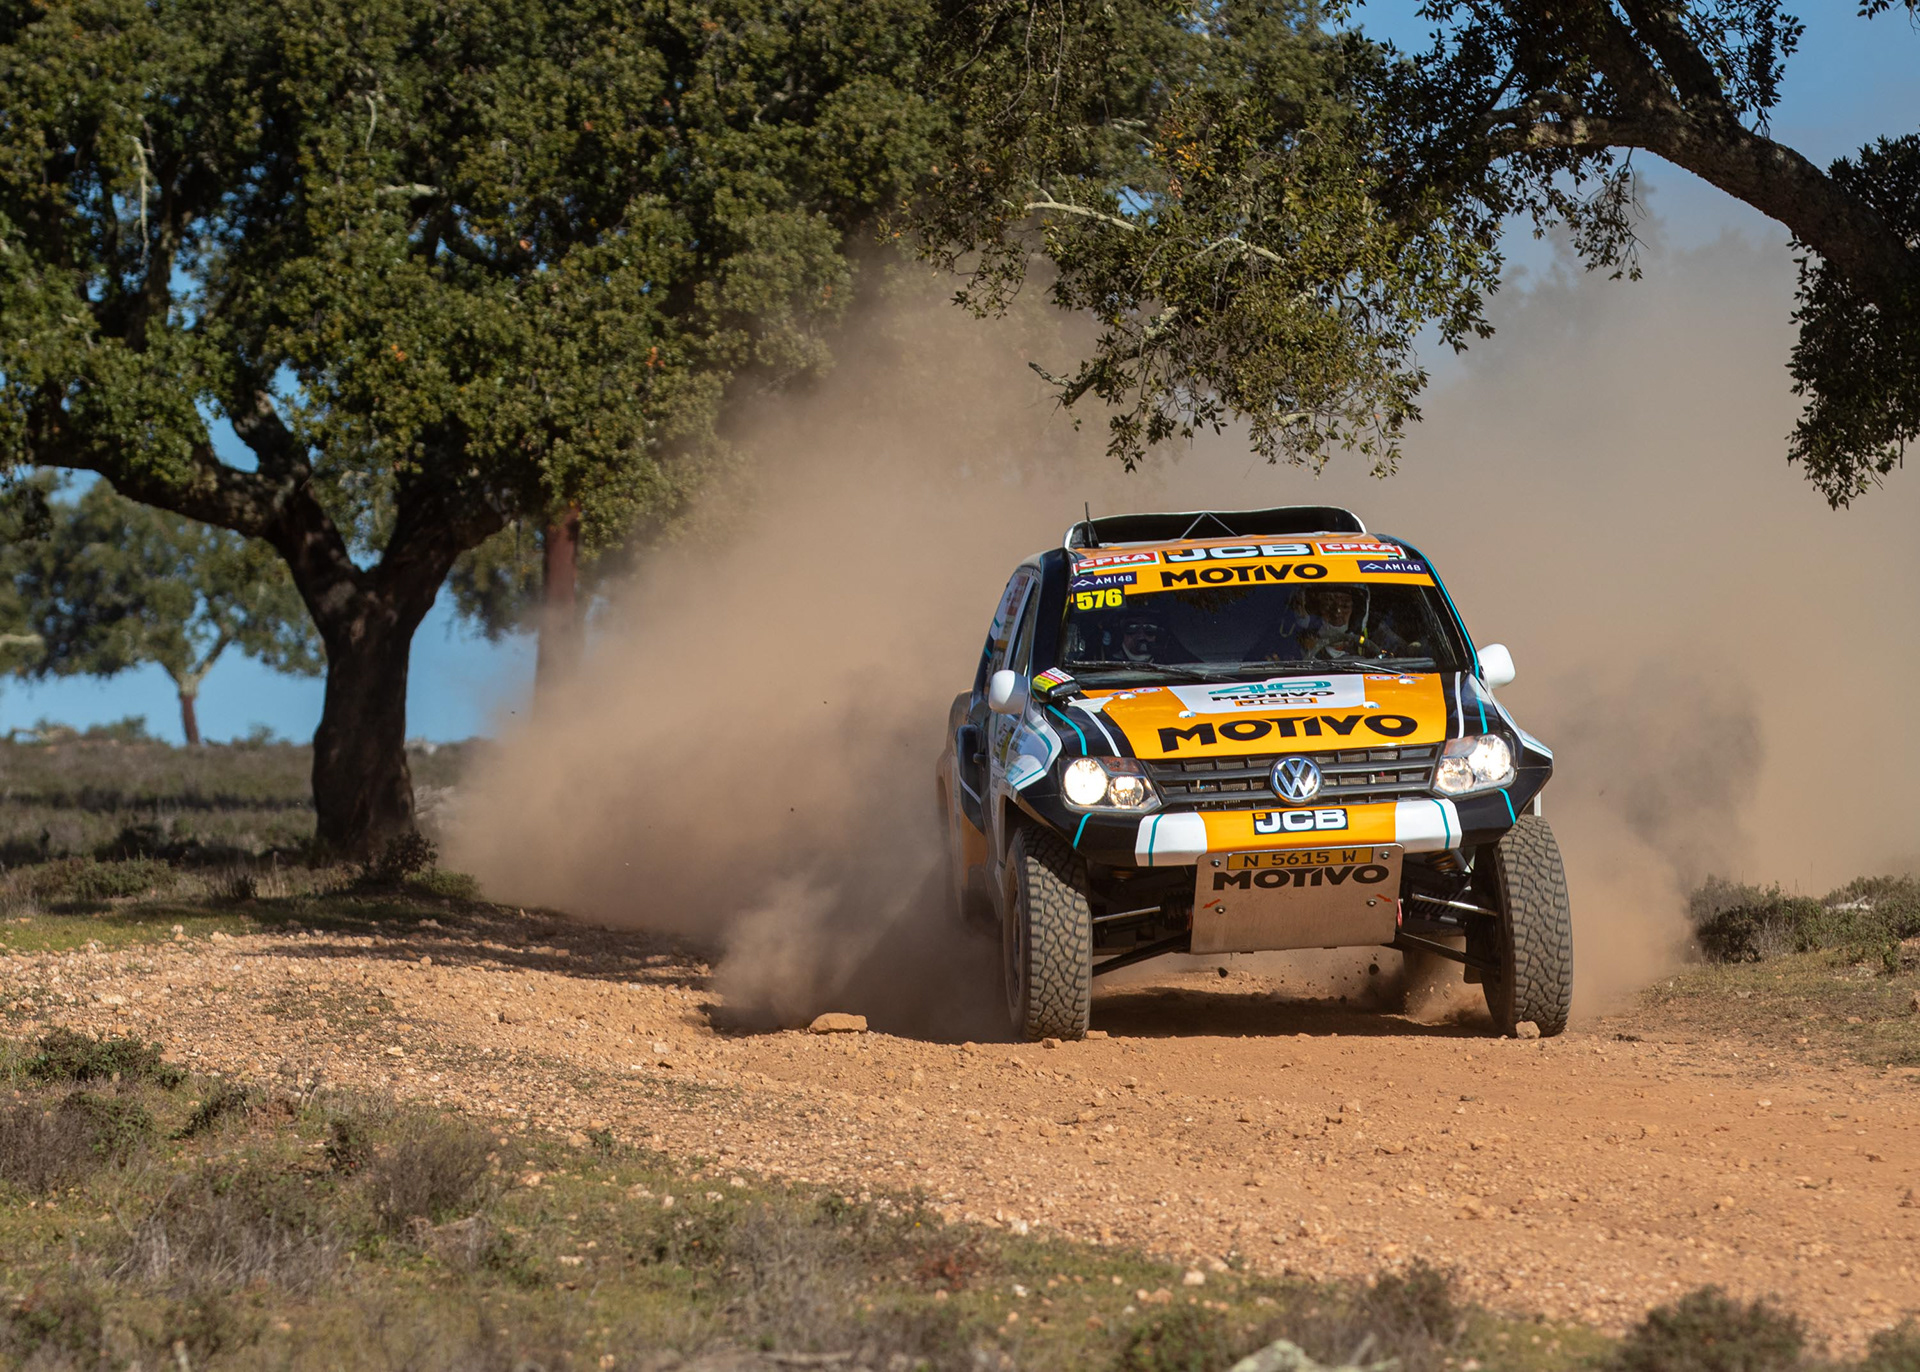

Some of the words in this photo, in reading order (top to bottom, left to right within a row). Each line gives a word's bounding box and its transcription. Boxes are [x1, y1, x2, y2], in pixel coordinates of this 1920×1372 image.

[1168, 543, 1310, 562] JCB
[1160, 563, 1328, 587] MOTIVO
[1076, 588, 1123, 611] 576
[1157, 714, 1418, 753] MOTIVO
[1255, 808, 1347, 834] JCB
[1243, 855, 1258, 867] N
[1272, 851, 1329, 866] 5615
[1343, 850, 1356, 862] W
[1213, 865, 1389, 890] MOTIVO
